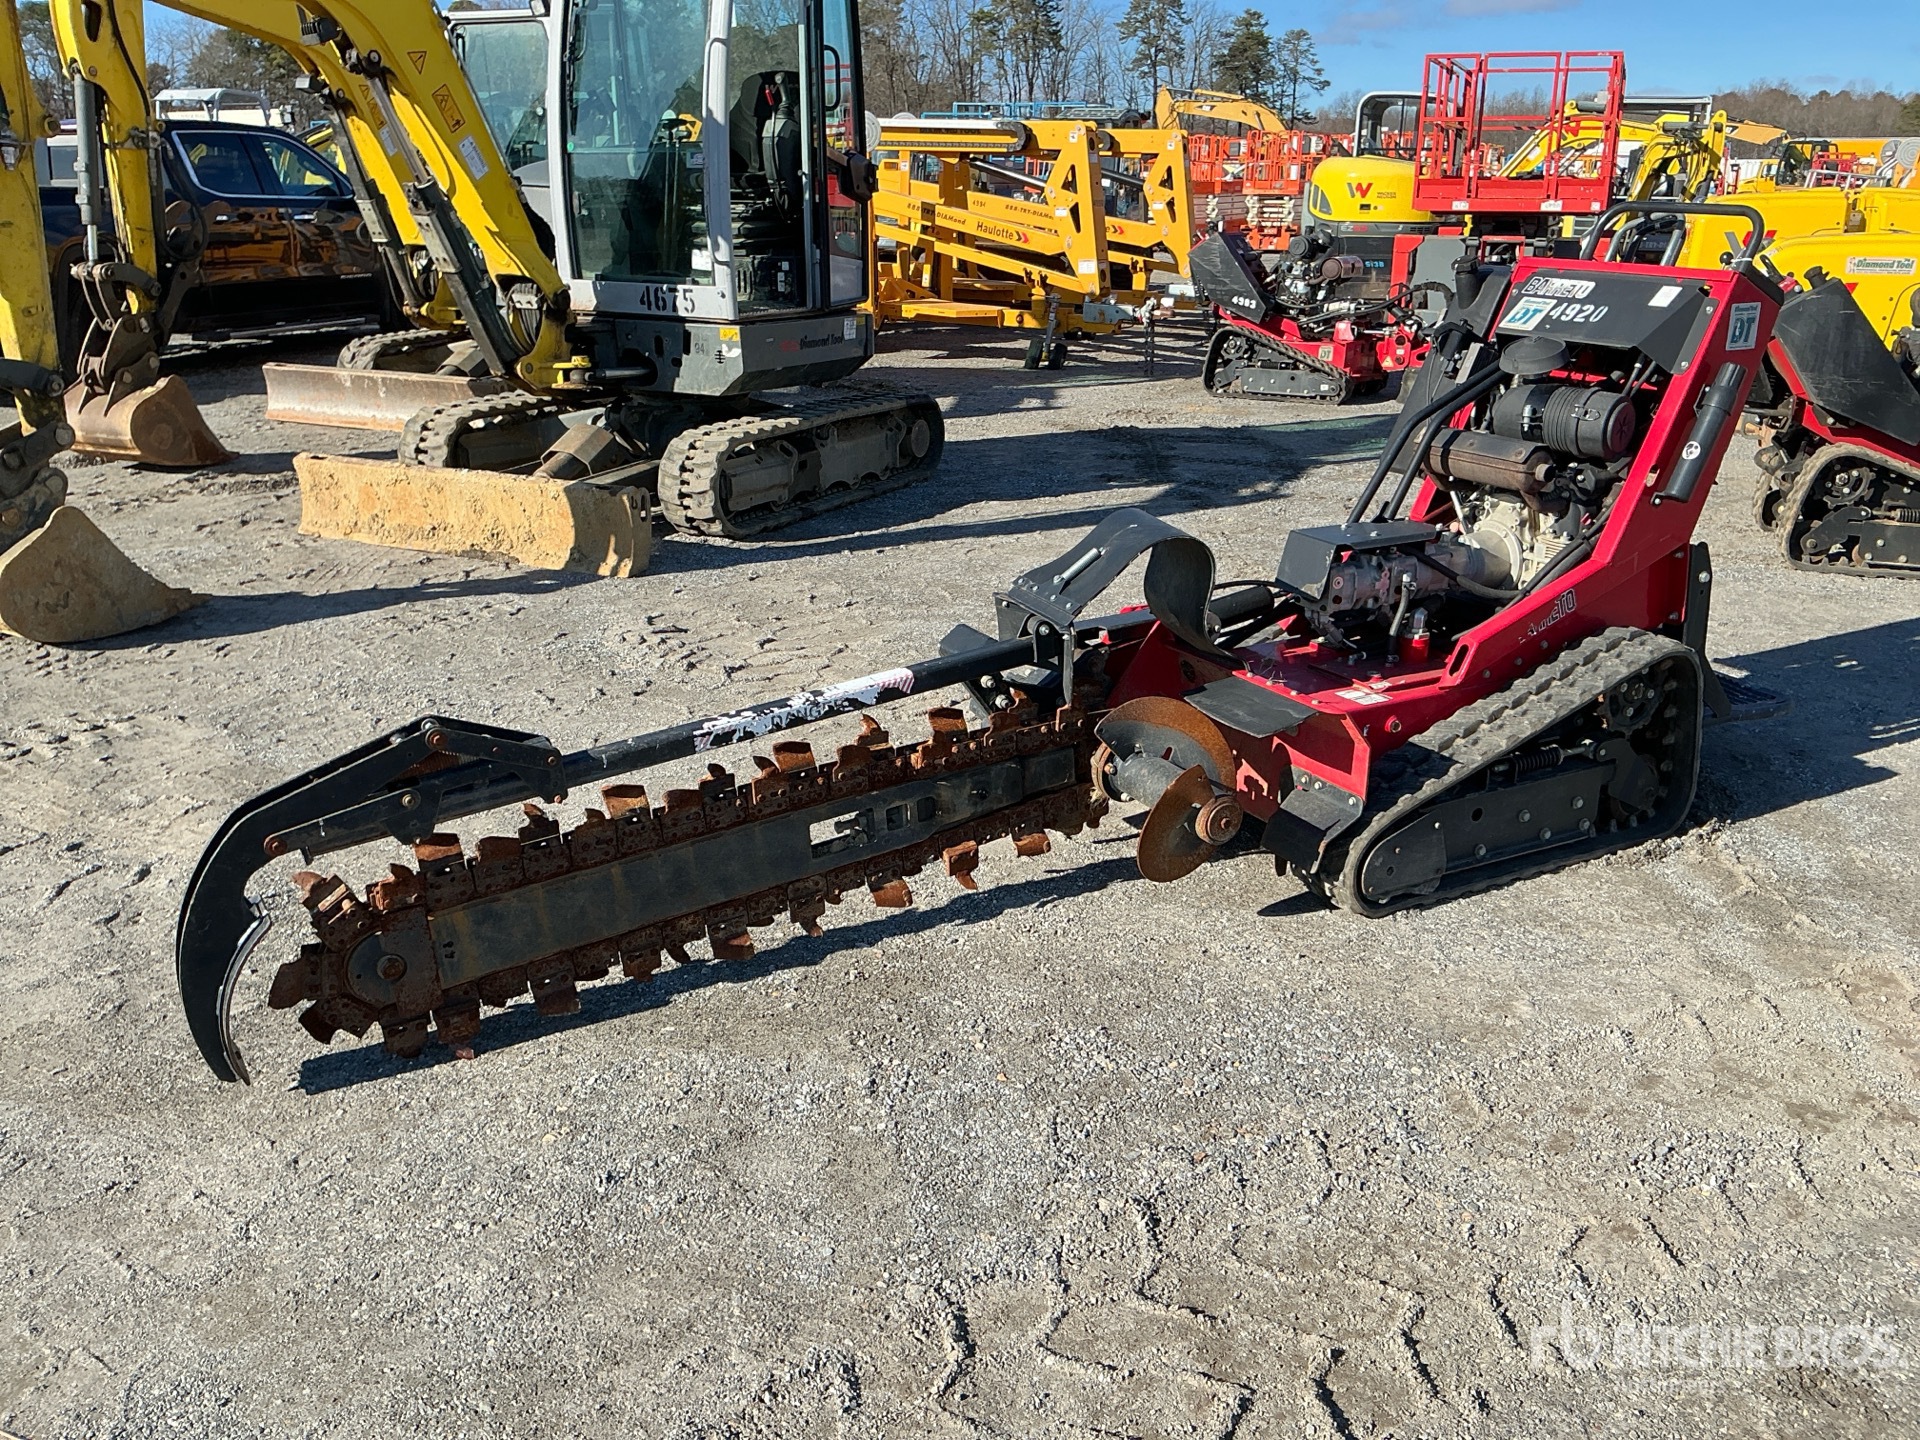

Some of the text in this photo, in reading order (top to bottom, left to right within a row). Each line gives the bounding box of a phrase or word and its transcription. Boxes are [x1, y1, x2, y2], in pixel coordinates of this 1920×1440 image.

[976, 220, 1014, 242] Haulotte
[1856, 258, 1915, 269] Diamond Tool
[1521, 276, 1596, 299] BARRETO
[639, 285, 696, 314] 4675
[1507, 307, 1545, 325] DT
[1549, 302, 1609, 323] 4920
[1730, 317, 1756, 343] DT
[799, 334, 830, 350] Diamond
[1319, 349, 1332, 359] DT
